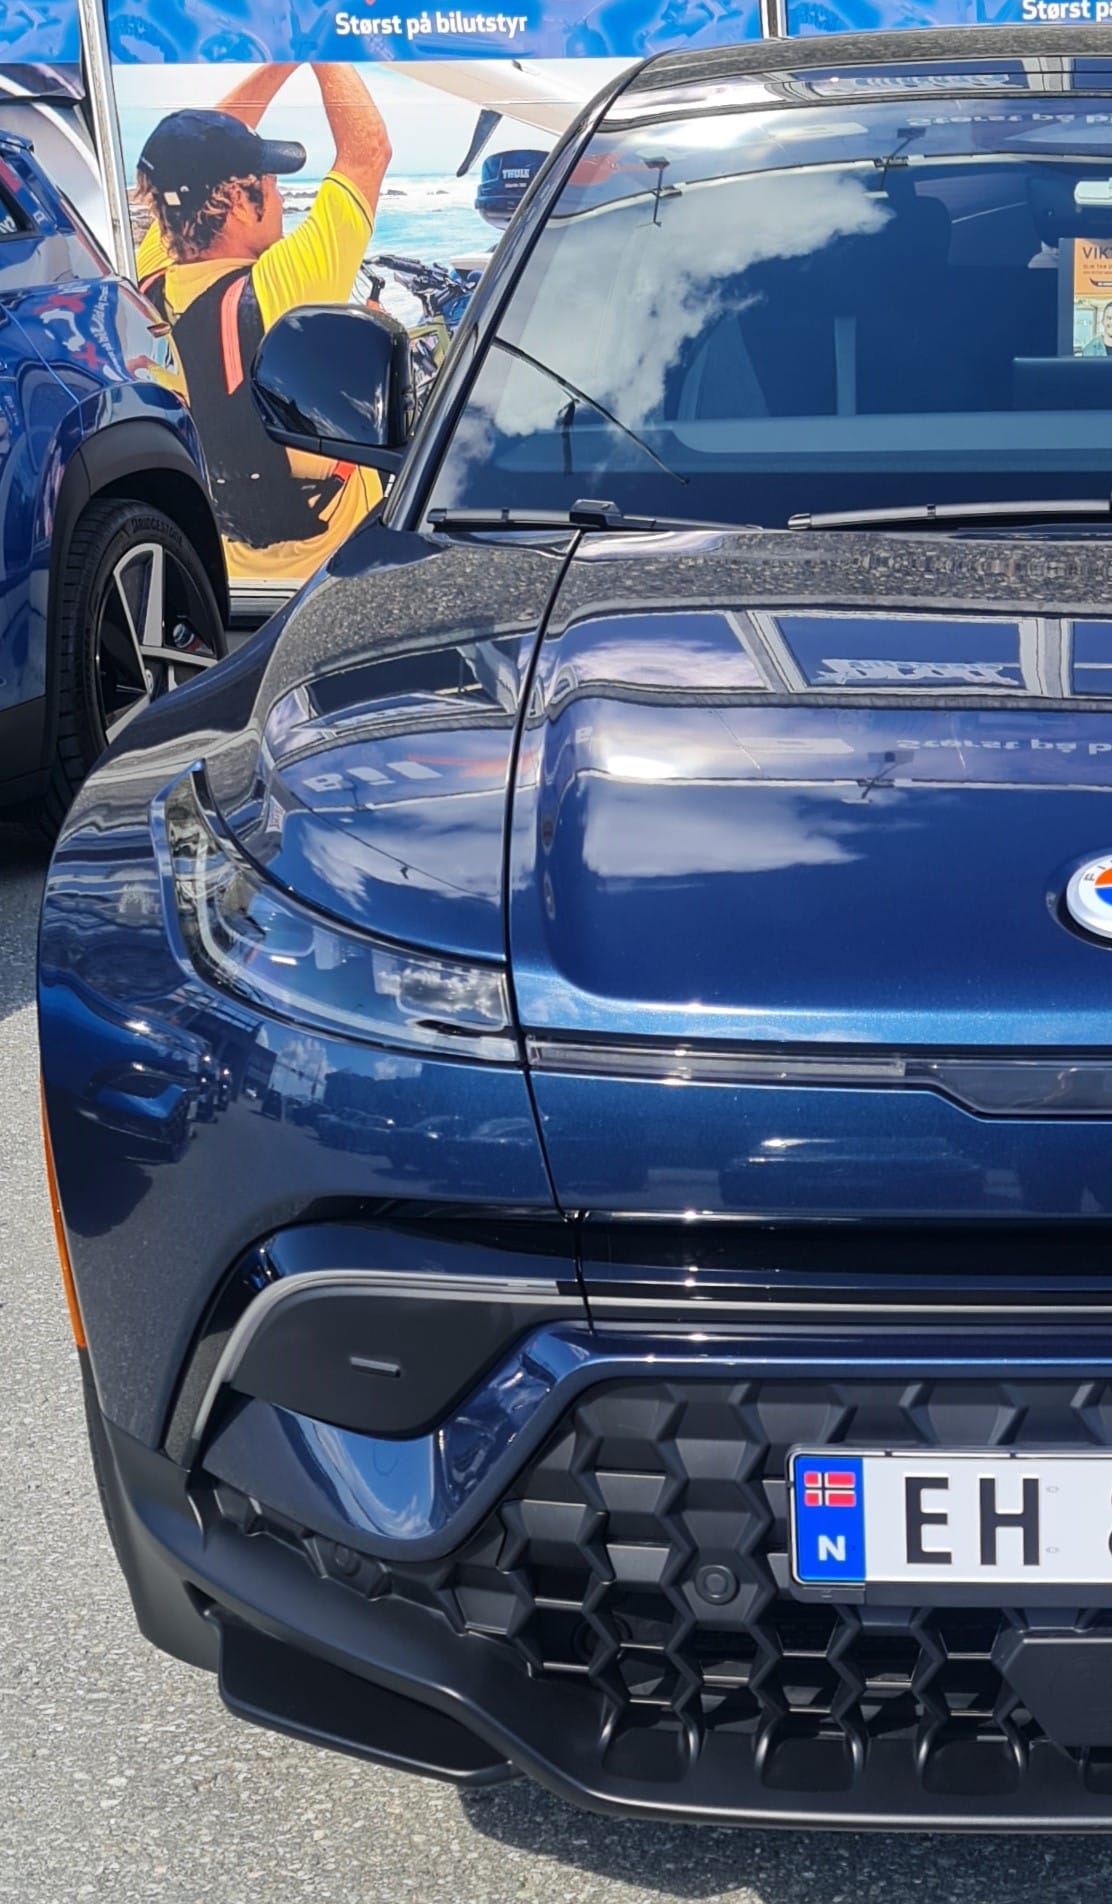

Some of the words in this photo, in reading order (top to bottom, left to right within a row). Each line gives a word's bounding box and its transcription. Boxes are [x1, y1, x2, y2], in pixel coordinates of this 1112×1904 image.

[1022, 0, 1091, 20] Størst
[335, 12, 402, 35] Størst
[406, 11, 432, 40] på
[436, 11, 528, 38] bilutstyr
[502, 168, 530, 179] THULE
[904, 1476, 1041, 1566] EH
[817, 1535, 847, 1561] N
